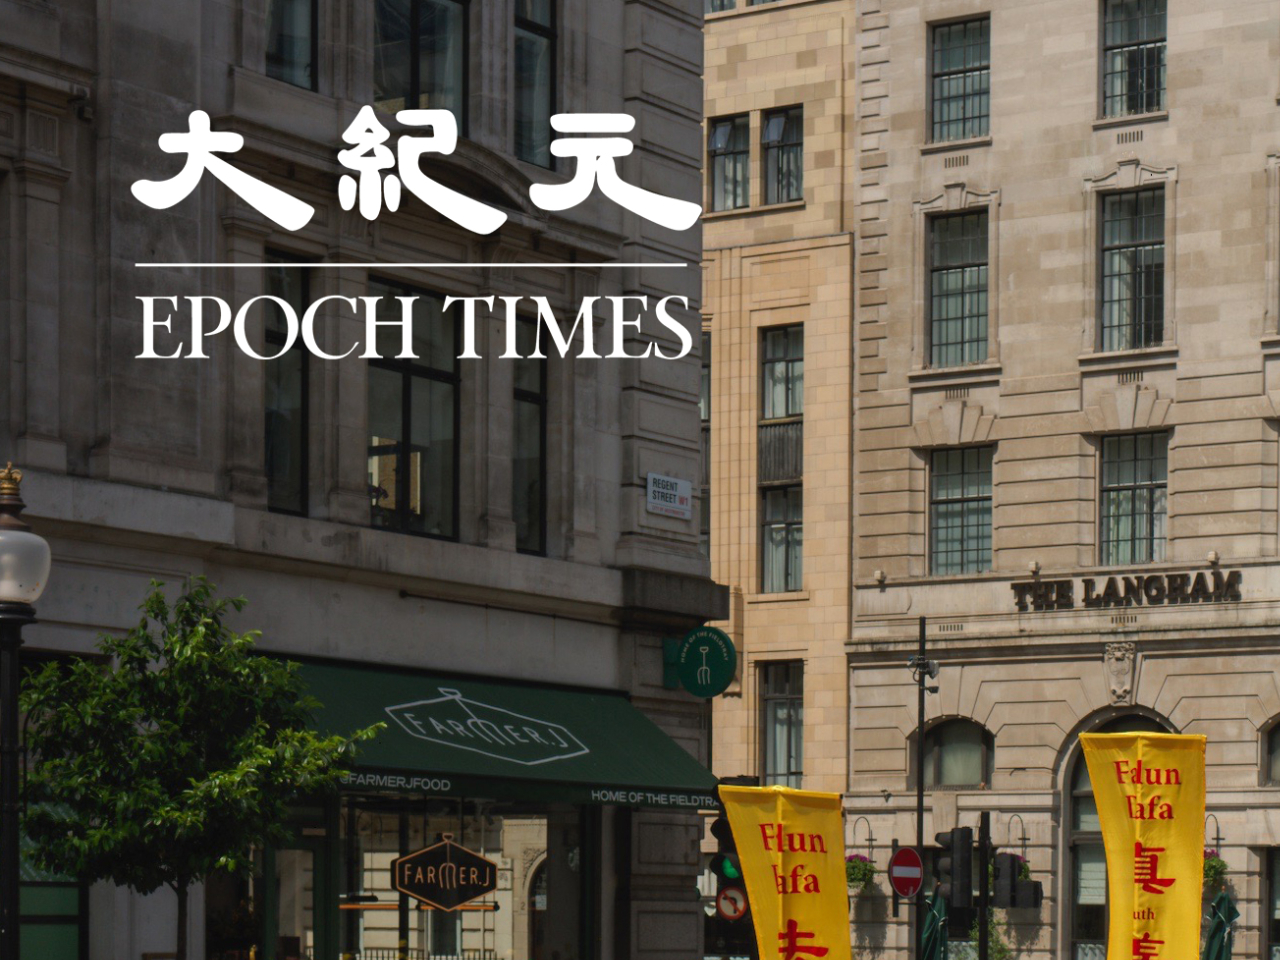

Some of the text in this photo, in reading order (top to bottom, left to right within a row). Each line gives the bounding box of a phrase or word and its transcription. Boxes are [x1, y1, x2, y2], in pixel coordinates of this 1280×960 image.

[652, 477, 678, 492] REGENT
[652, 490, 689, 507] STREET W1
[1010, 570, 1243, 612] THE LANGHAM
[591, 790, 720, 807] HOME OF THE FIELDTRA
[758, 823, 828, 854] Flun
[771, 864, 821, 895] afa
[1132, 907, 1155, 920] uth
